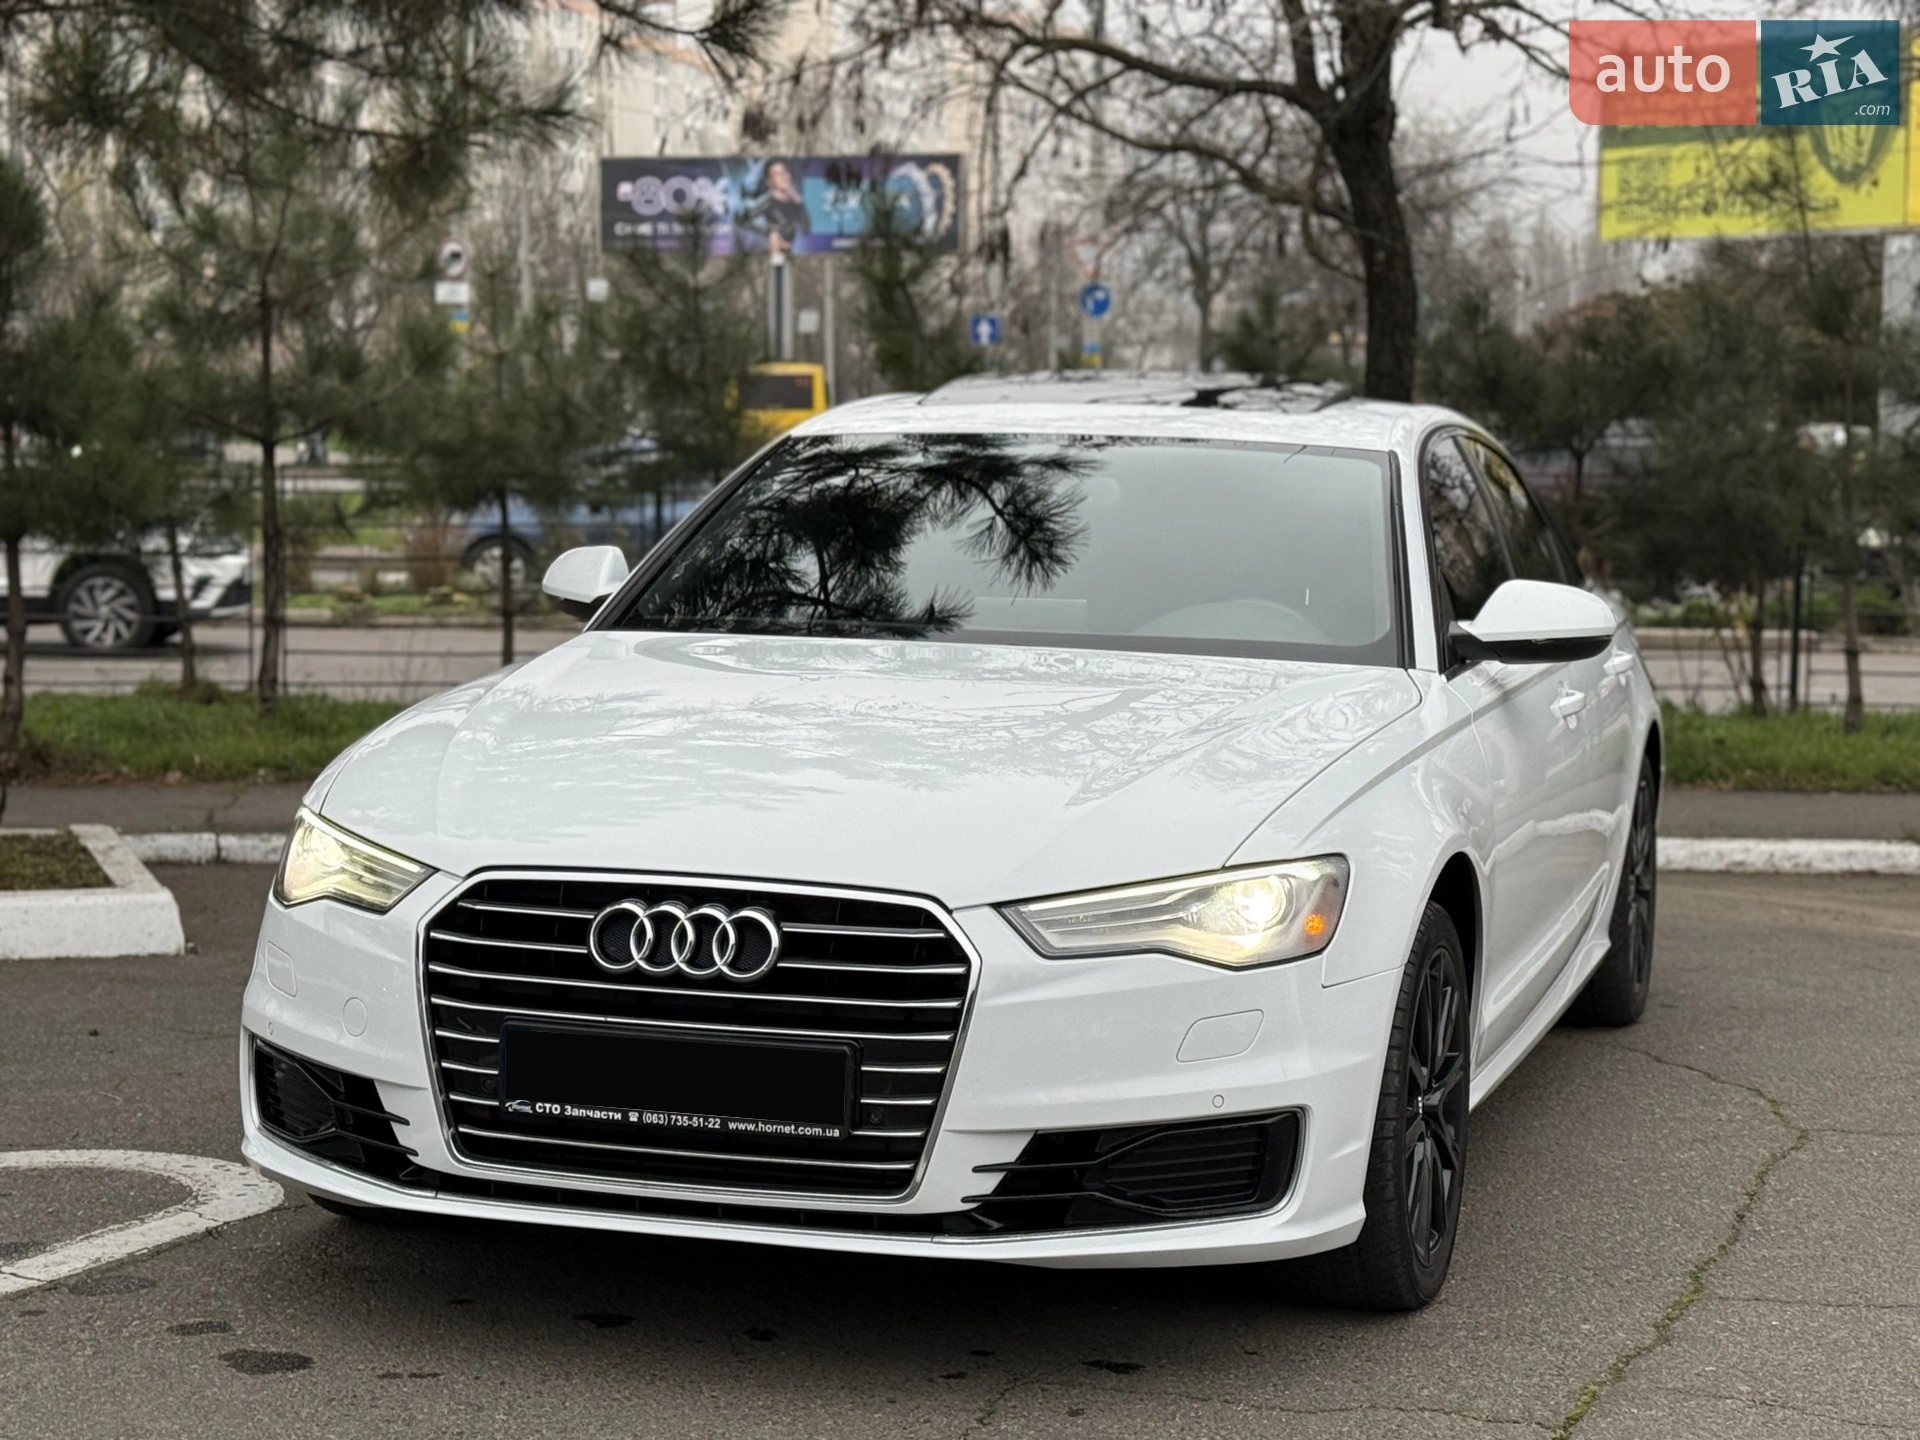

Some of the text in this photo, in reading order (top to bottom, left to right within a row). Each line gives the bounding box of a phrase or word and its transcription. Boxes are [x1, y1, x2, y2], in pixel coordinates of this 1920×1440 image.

[535, 1102, 840, 1138] СТО Запчасти (063) 735-51-22 www.hornet.com.ua
